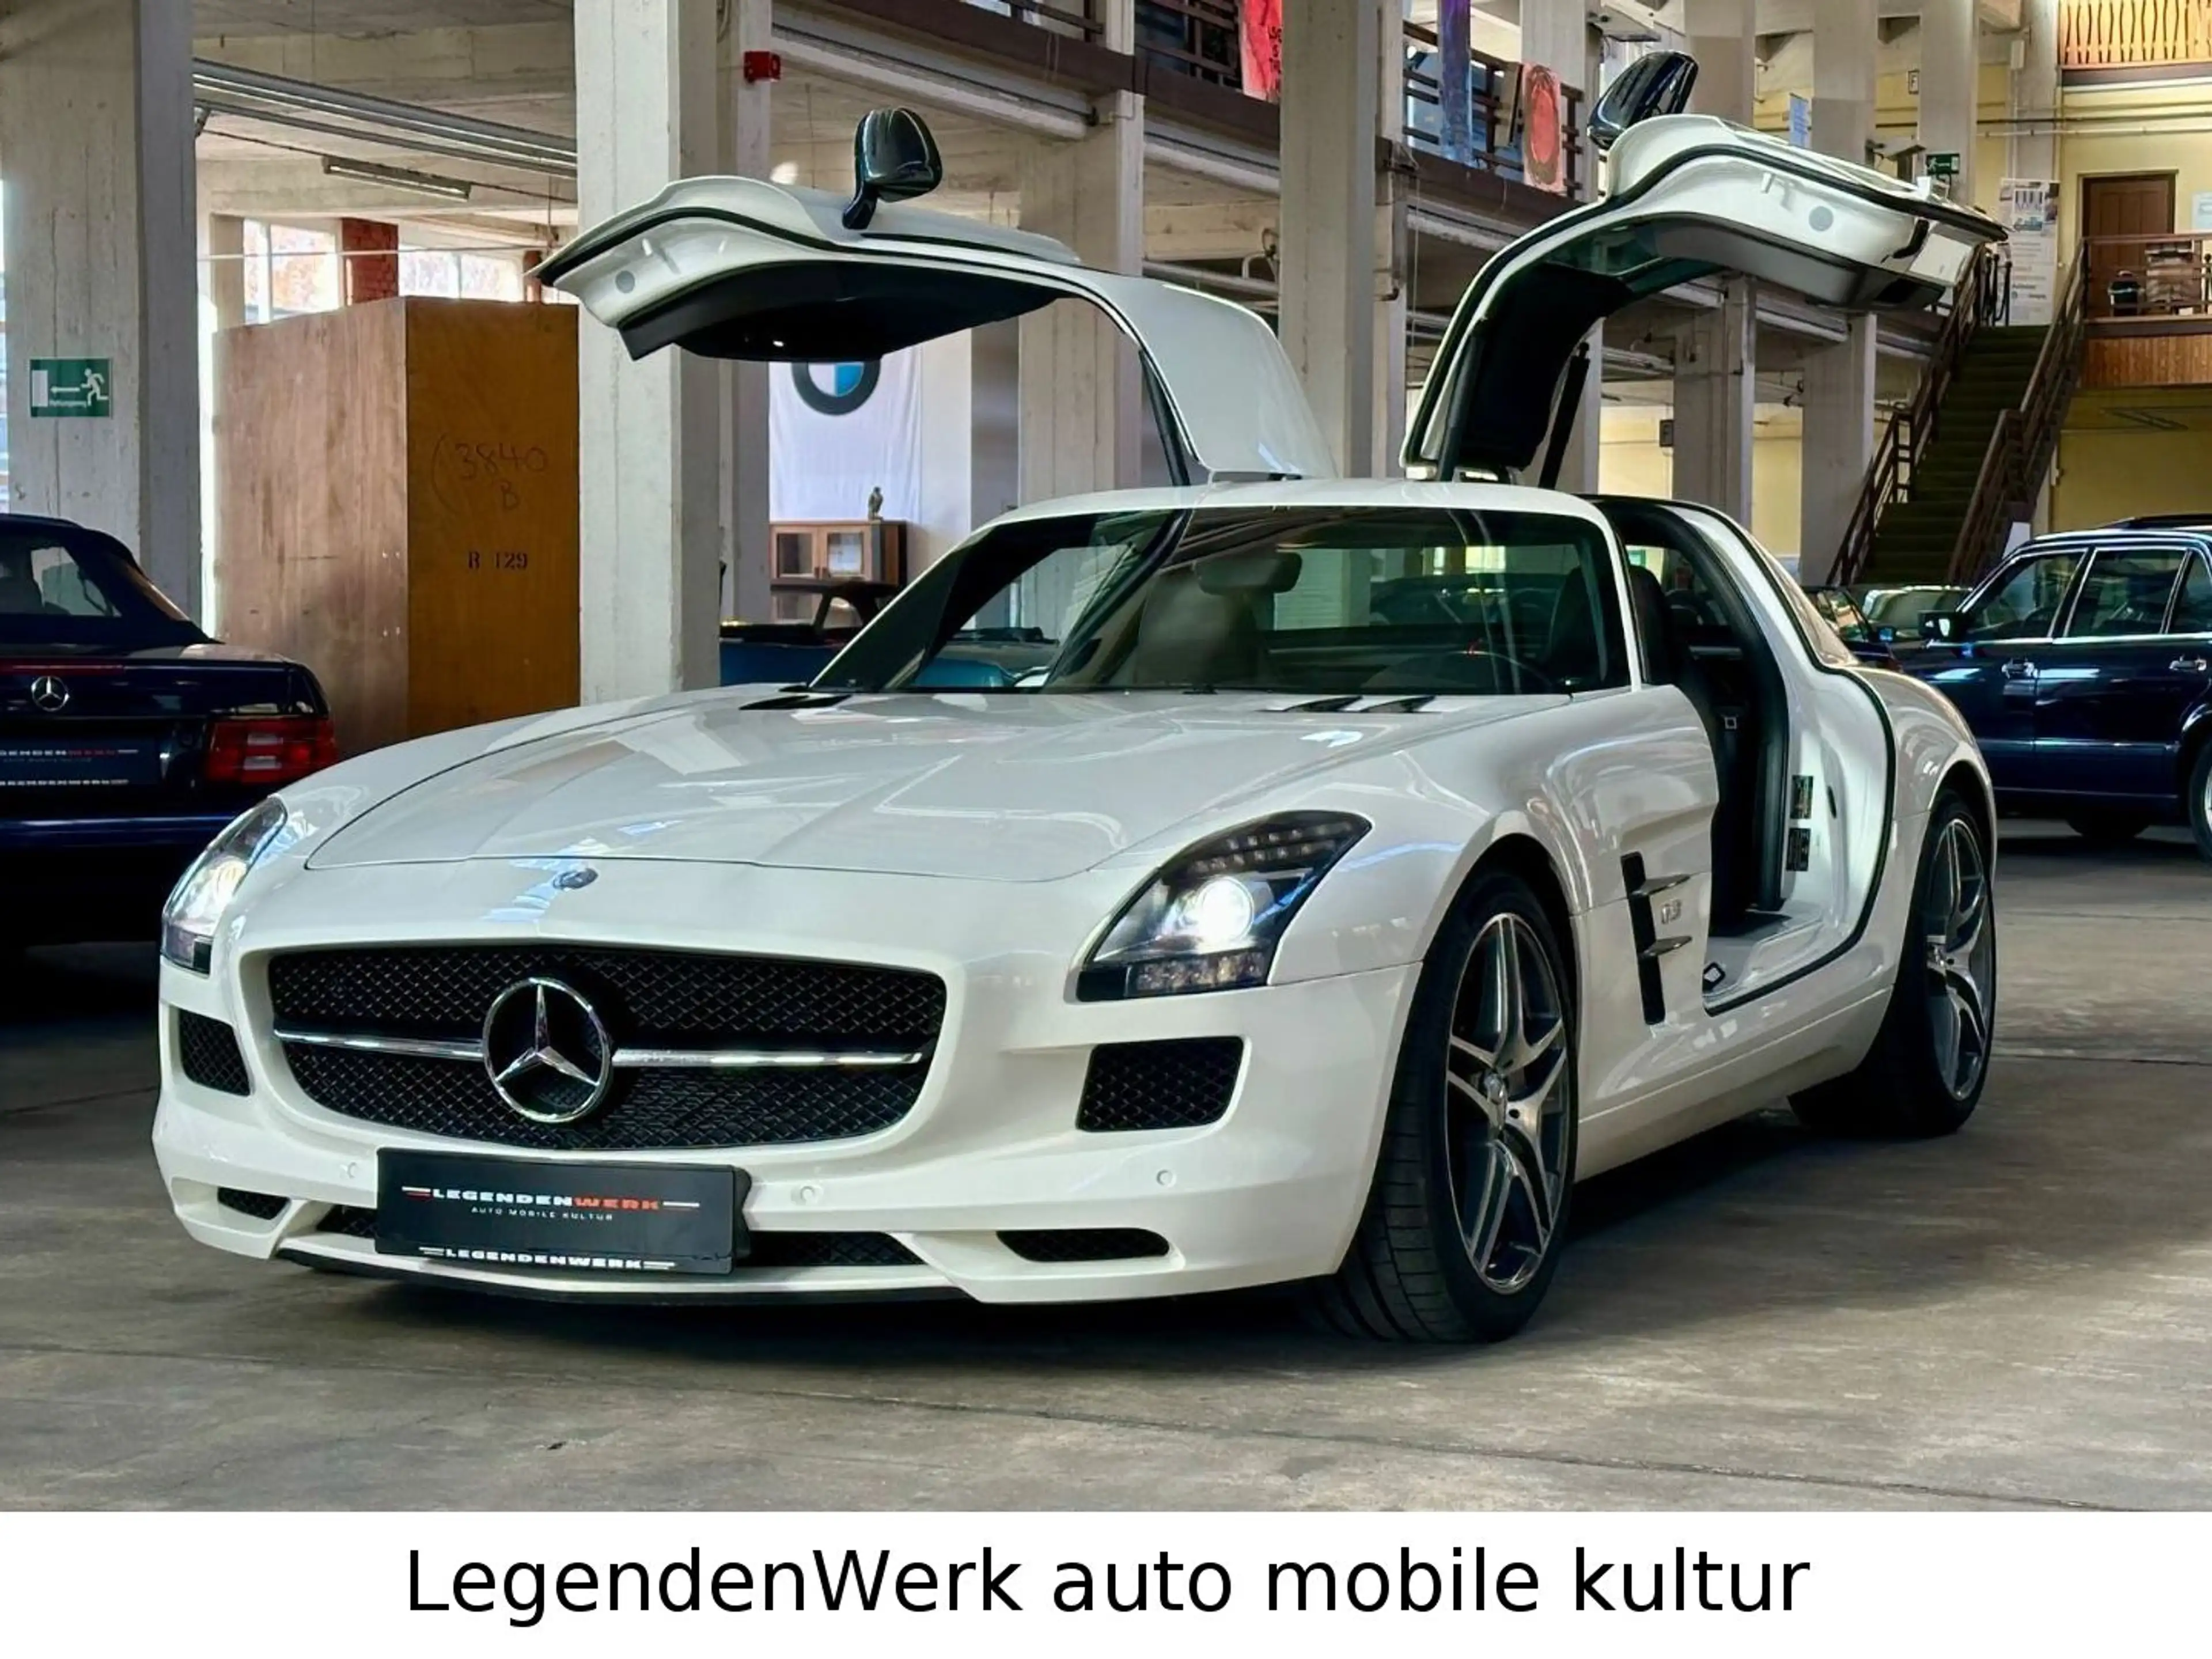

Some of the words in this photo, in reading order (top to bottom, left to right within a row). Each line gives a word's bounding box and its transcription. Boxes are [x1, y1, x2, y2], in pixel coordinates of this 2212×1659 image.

[495, 552, 528, 570] 129
[433, 1188, 659, 1210] LEGENDENWERK
[471, 1206, 502, 1215] AUTO
[509, 1209, 555, 1218] MOBILE
[562, 1212, 613, 1221] KULTUR
[445, 1248, 642, 1270] LEGENDENWERK
